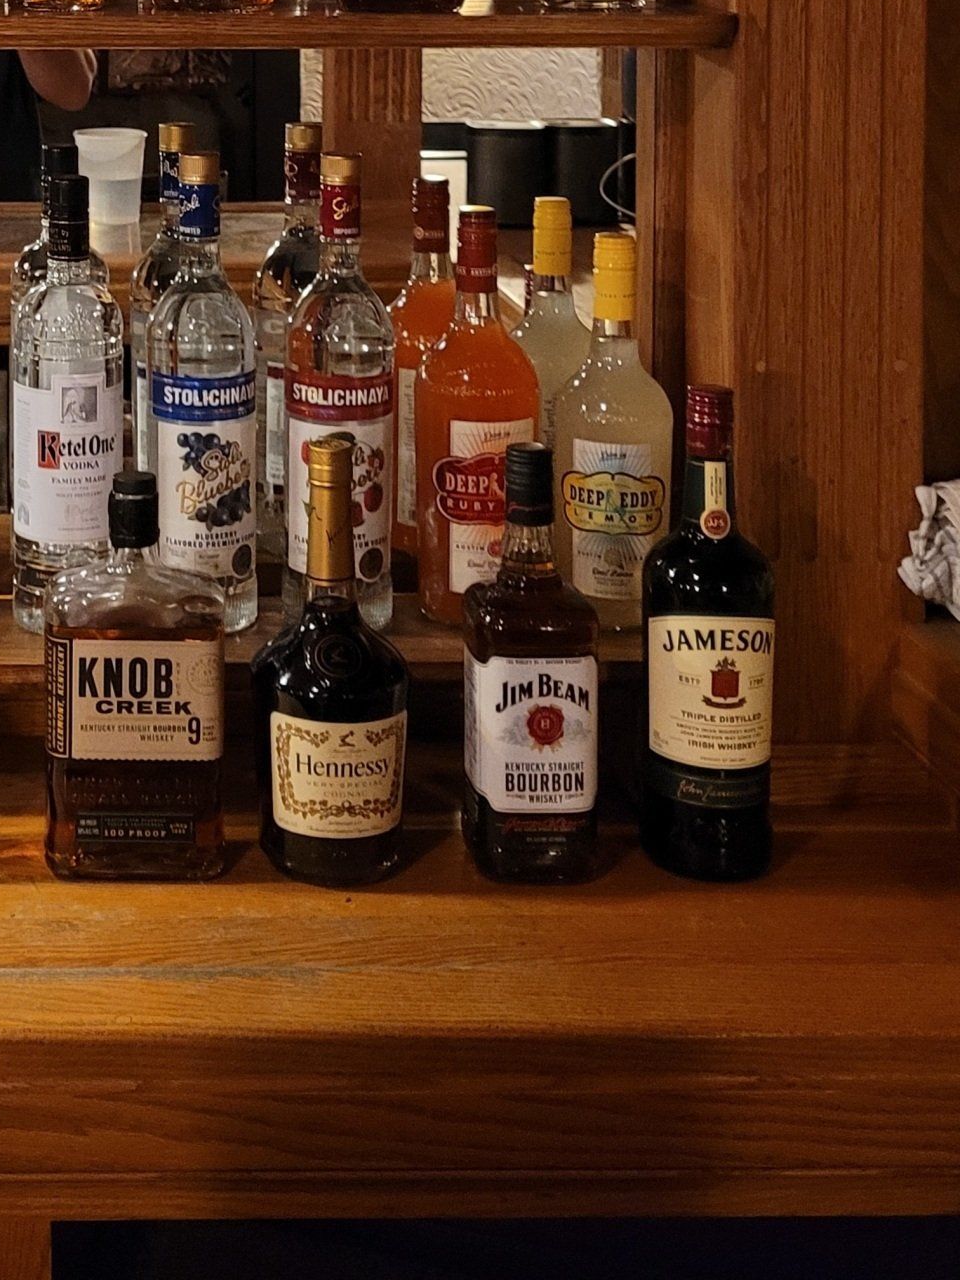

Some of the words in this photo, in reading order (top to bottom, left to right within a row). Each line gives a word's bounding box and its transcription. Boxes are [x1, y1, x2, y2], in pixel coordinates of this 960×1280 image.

[293, 383, 389, 407] STOLICHNAYA
[40, 433, 87, 468] Ketel
[89, 434, 115, 456] One
[63, 460, 100, 470] VODKA
[51, 476, 82, 484] FAMILY
[85, 474, 106, 483] MADE
[445, 472, 489, 494] DEEP
[569, 483, 605, 507] DEEP
[620, 489, 659, 508] EDDY
[446, 497, 495, 512] RUBY
[573, 508, 654, 524] LEMON
[166, 537, 203, 548] FLAVORED
[206, 538, 240, 548] PREMIUM
[195, 531, 237, 541] BLUEBERRY
[662, 628, 773, 654] JAMESON
[57, 644, 65, 697] KENTUCKY
[78, 656, 173, 699] KNOB
[495, 681, 534, 713] JIM
[538, 673, 590, 712] BEAM
[95, 700, 192, 716] CREEK
[680, 710, 716, 722] TRIPLE
[719, 712, 762, 724] DISTILLED
[56, 700, 65, 753] CLERMONT,
[80, 724, 115, 732] KENTUCKY
[118, 724, 150, 733] STRAIGHT
[153, 725, 187, 733] BOURBON
[187, 716, 201, 746] 9
[140, 734, 175, 742] WHISKEY
[696, 732, 723, 740] JAMESON
[688, 739, 715, 750] IRISH
[717, 739, 758, 751] WHISKEY
[295, 753, 389, 780] Hennessy
[505, 762, 546, 772] KENTUCKY
[548, 761, 584, 772] STRAIGHT
[306, 781, 334, 789] VERY
[340, 780, 383, 789] SPECIAL
[505, 772, 584, 792] BOURBON
[324, 790, 366, 798] COGNAC
[528, 794, 563, 803] WHISKEY
[104, 828, 125, 838] 100
[129, 828, 167, 838] PROOF
